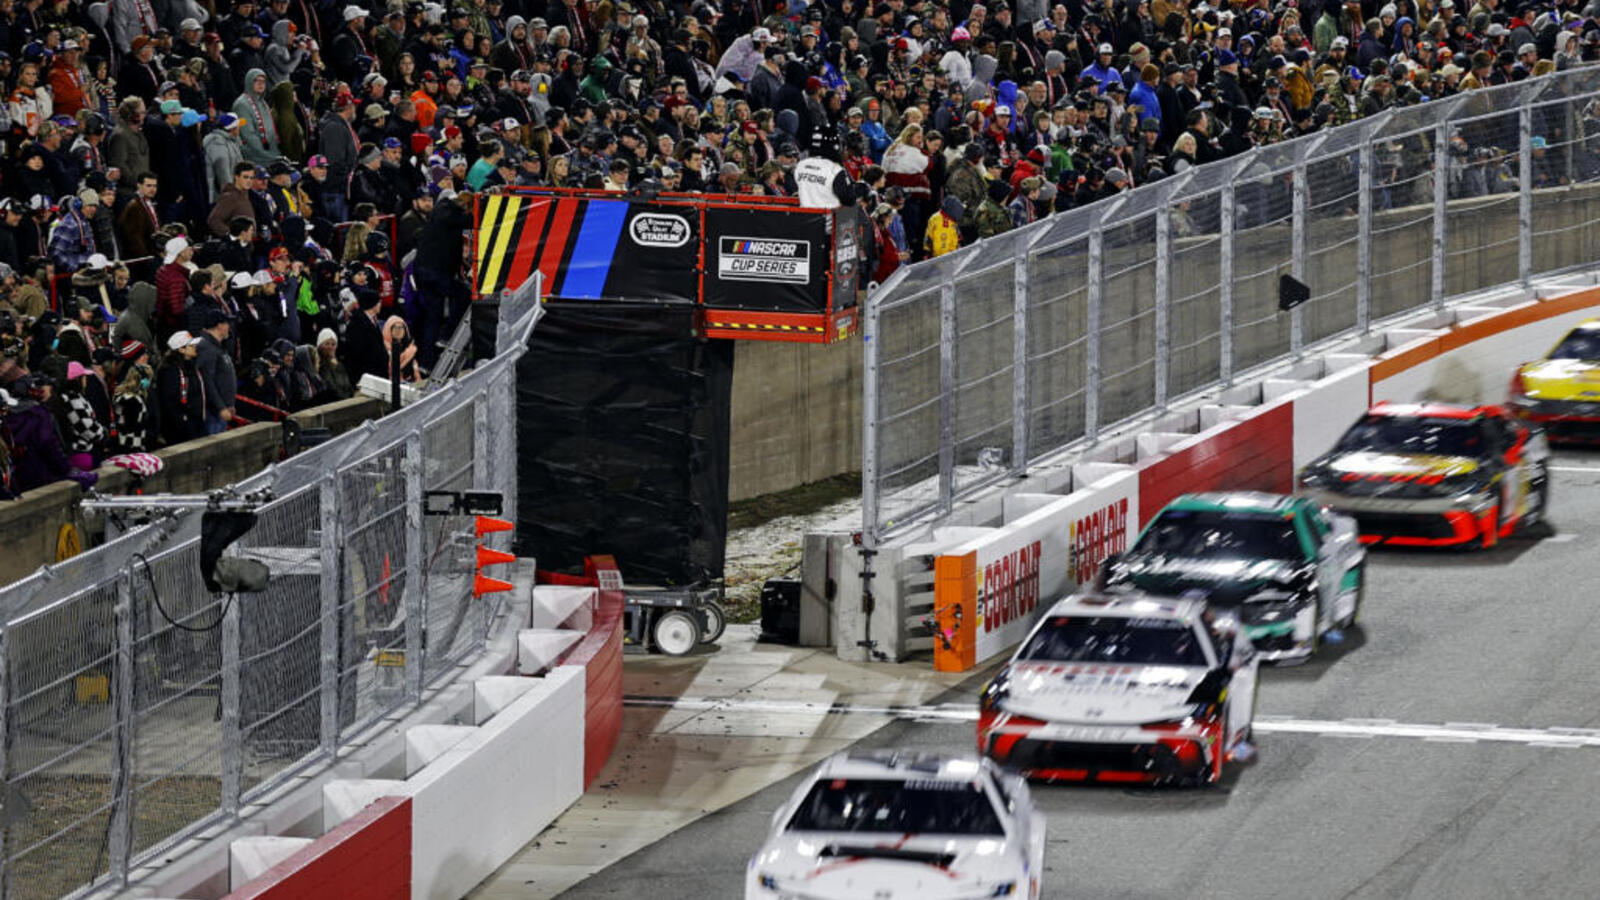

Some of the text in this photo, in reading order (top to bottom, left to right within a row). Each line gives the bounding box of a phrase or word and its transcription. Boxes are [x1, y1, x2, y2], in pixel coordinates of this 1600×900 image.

[641, 232, 681, 242] STADIUM
[748, 241, 797, 256] NASCAR
[731, 259, 798, 274] CUP SERIES
